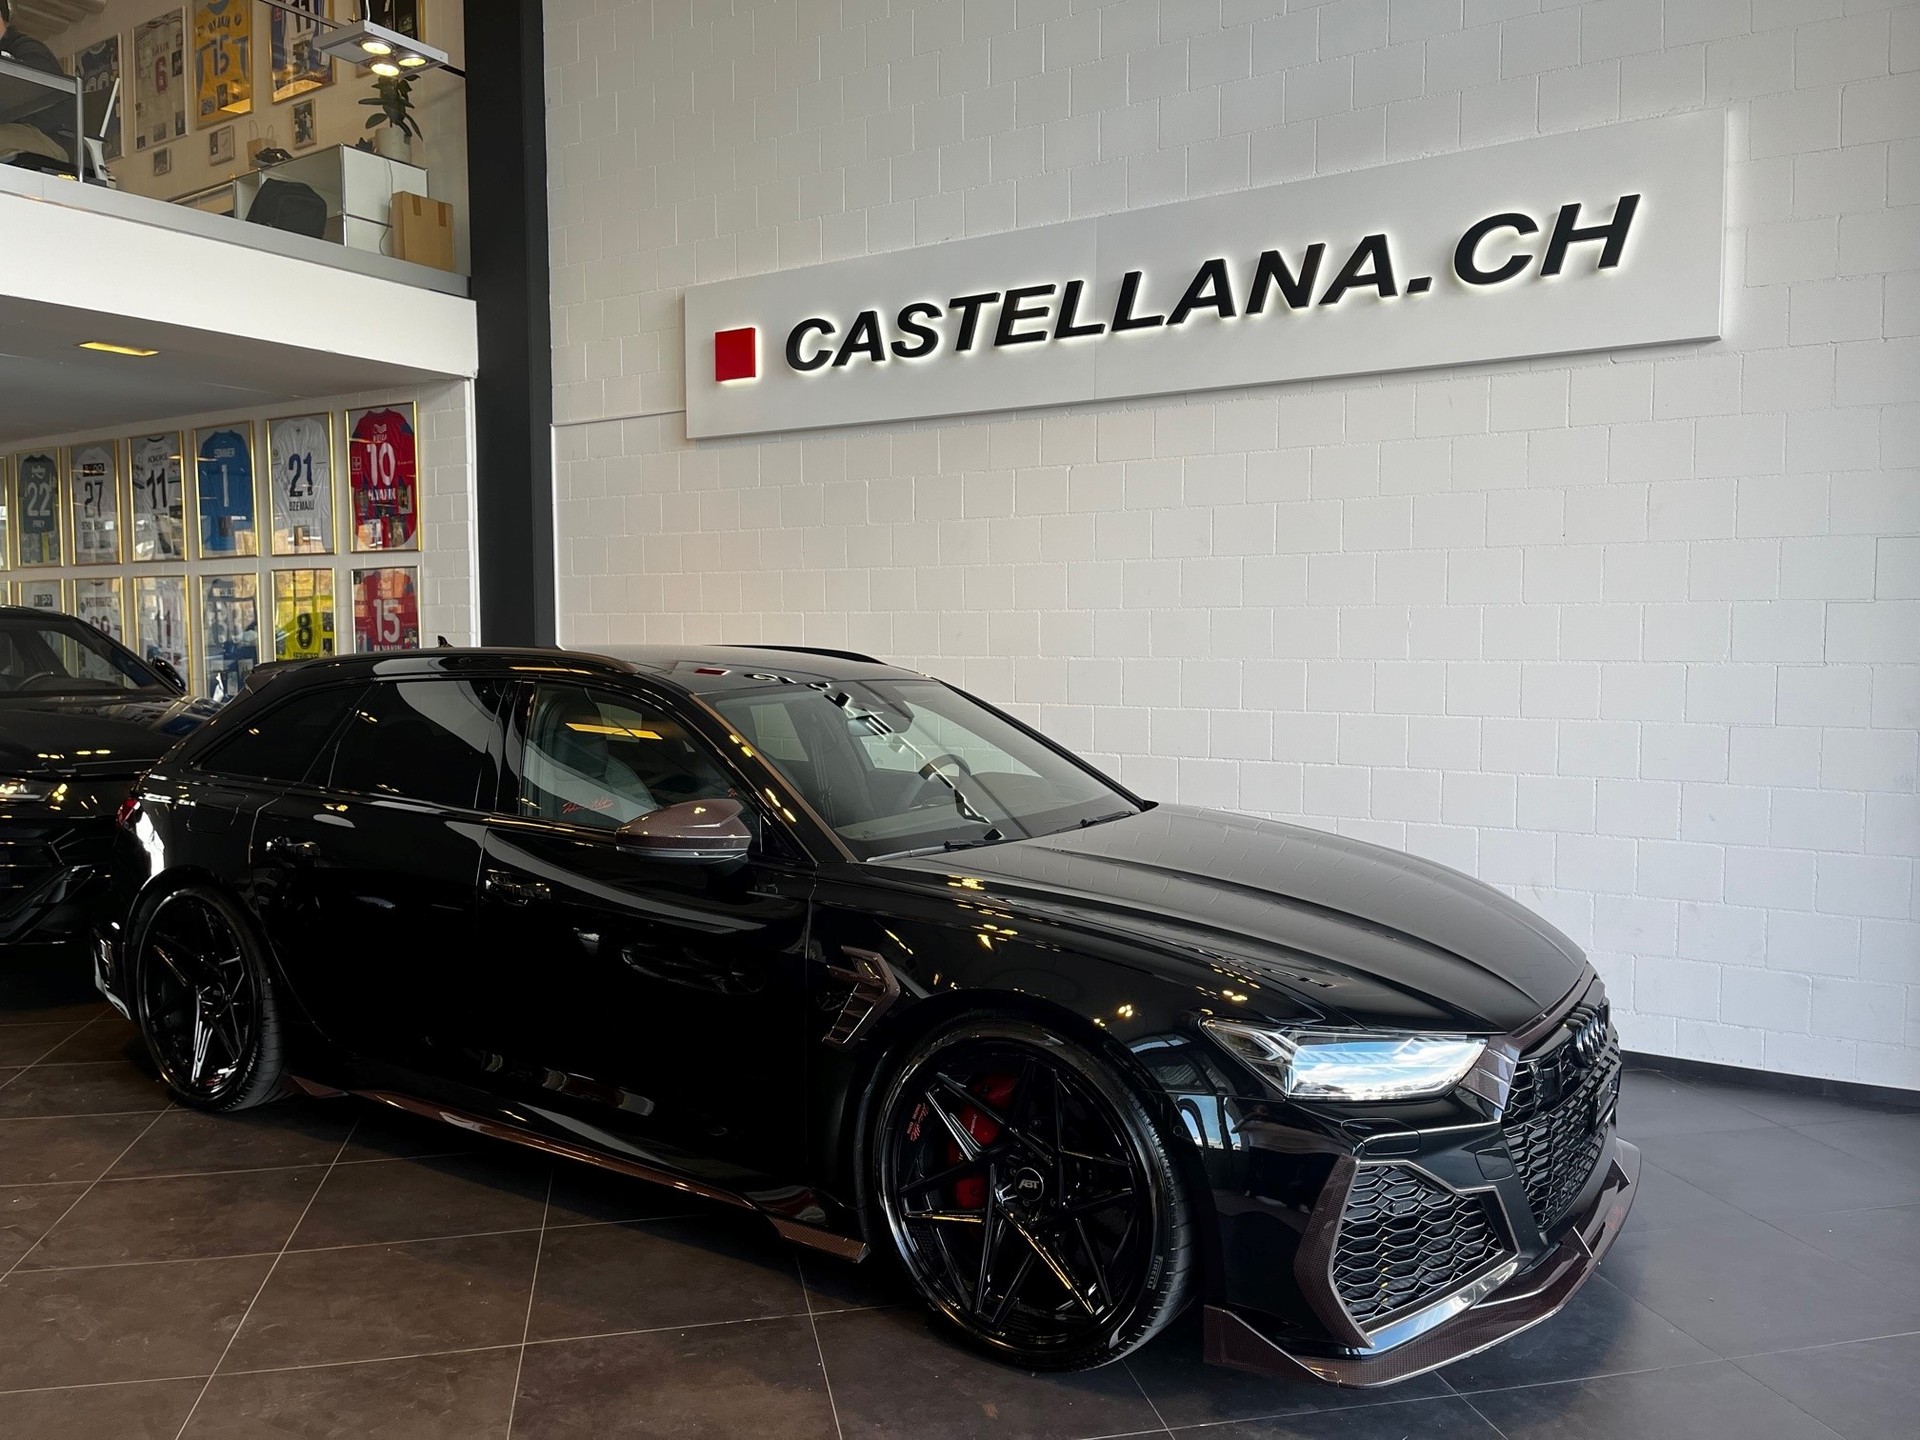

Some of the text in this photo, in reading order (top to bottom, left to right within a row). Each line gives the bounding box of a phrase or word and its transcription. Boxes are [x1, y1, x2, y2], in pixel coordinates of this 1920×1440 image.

[785, 194, 1641, 372] CASTELLANA.CH
[288, 452, 313, 497] 21
[366, 442, 396, 486] 10
[27, 482, 51, 517] 22
[84, 480, 103, 518] 27
[146, 468, 167, 509] 11
[221, 464, 230, 508] 1
[296, 613, 313, 650] 8
[373, 599, 400, 643] 15
[1018, 1179, 1040, 1189] ABT
[1147, 1254, 1164, 1290] PIRELLI
